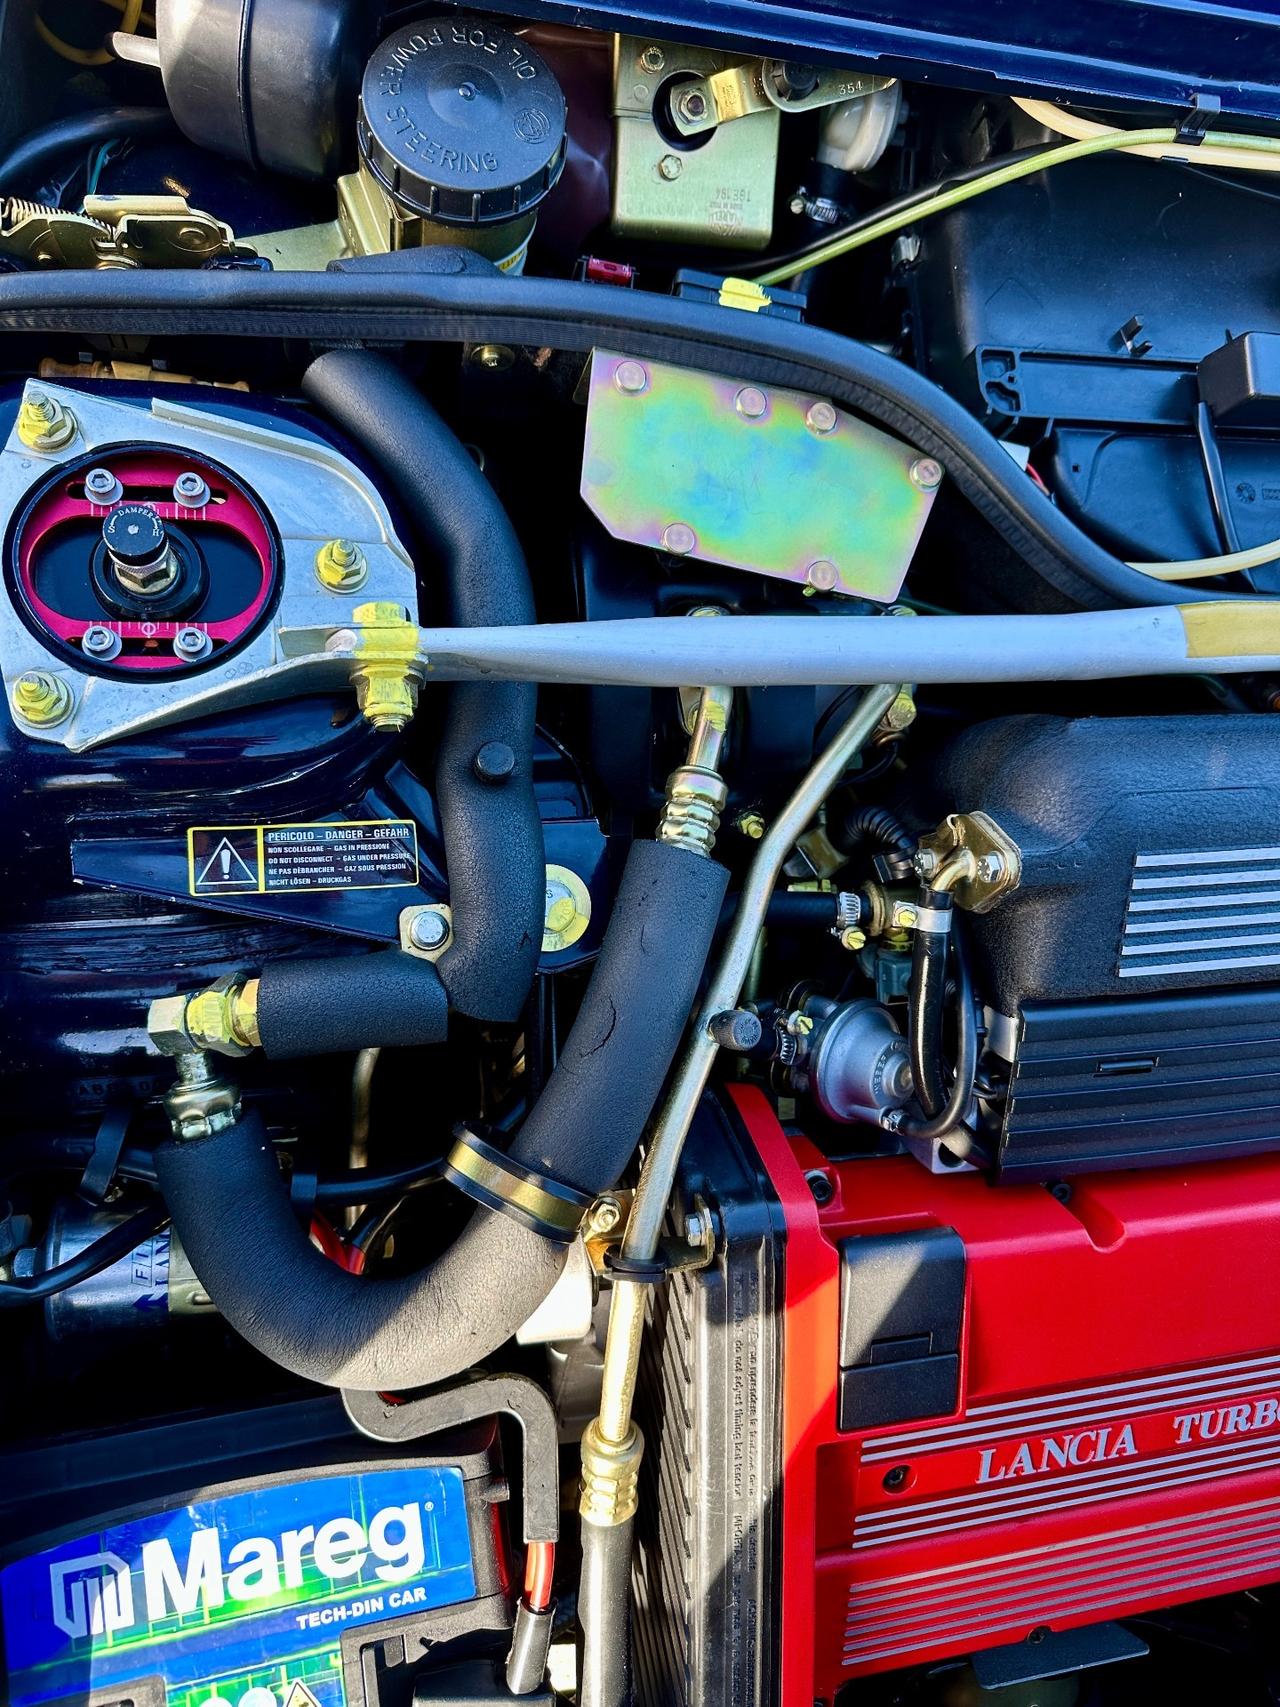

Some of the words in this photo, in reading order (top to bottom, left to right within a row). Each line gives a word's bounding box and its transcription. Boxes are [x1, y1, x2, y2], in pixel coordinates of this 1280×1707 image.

[451, 26, 498, 54] FOR
[379, 28, 444, 96] POWER
[508, 48, 537, 80] OIL
[838, 80, 863, 95] 354
[386, 106, 499, 173] STEERING
[118, 506, 154, 519] DAMPER
[152, 528, 160, 537] H
[268, 831, 314, 842] PERICOLO
[325, 829, 363, 840] DANGER
[373, 828, 409, 839] GEFAHR
[283, 845, 324, 853] SCOLLEGARE
[333, 844, 347, 852] GAS
[293, 855, 333, 863] DISCONNECT
[379, 852, 411, 860] PRESSURE
[278, 867, 292, 875] PAS
[358, 864, 375, 872] SOUS
[290, 877, 311, 885] LÖSEN
[318, 876, 352, 884] DRUCKGAS
[975, 1424, 1139, 1484] LANCIA
[1173, 1398, 1280, 1444] TURB
[295, 1597, 384, 1630] TECH-DIN
[388, 1587, 427, 1609] CAR
